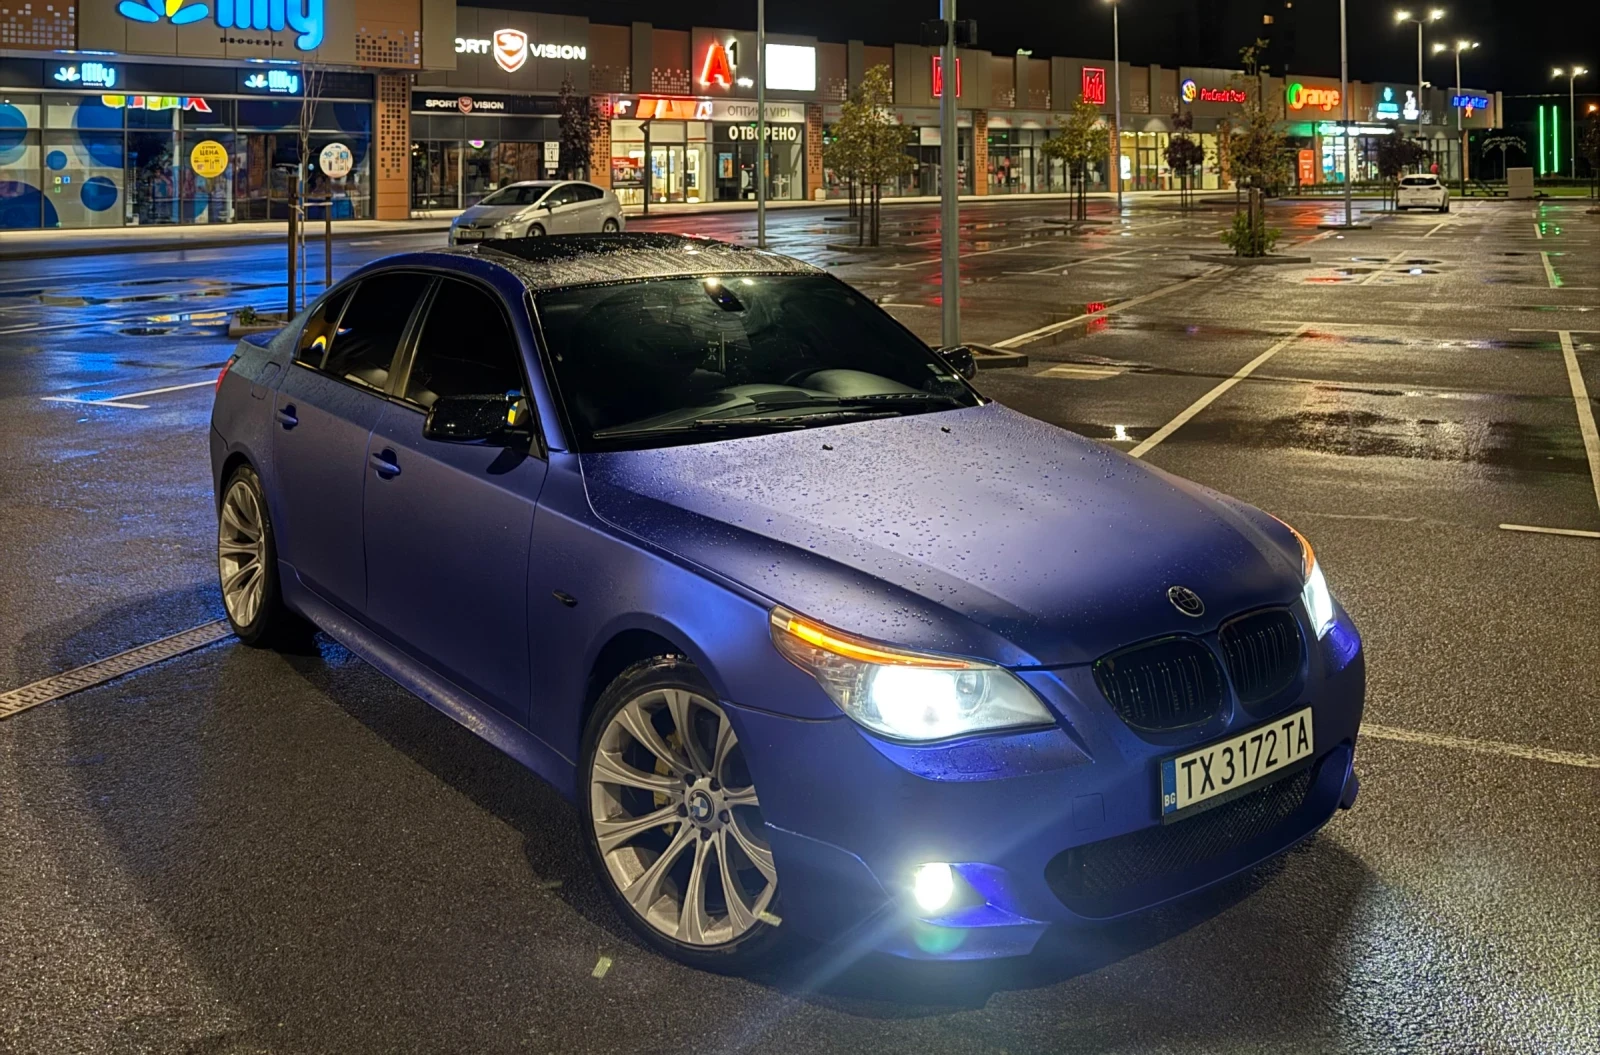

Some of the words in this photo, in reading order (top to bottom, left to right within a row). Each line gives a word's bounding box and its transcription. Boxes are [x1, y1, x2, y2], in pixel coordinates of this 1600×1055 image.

[529, 43, 587, 61] VISION
[701, 40, 738, 86] A1
[425, 99, 458, 108] SPORT
[473, 101, 504, 110] VISION
[1287, 82, 1340, 111] Orange
[1181, 752, 1215, 800] TX
[1221, 730, 1278, 785] 3172
[1281, 716, 1310, 759] TA
[1164, 792, 1176, 807] BG
